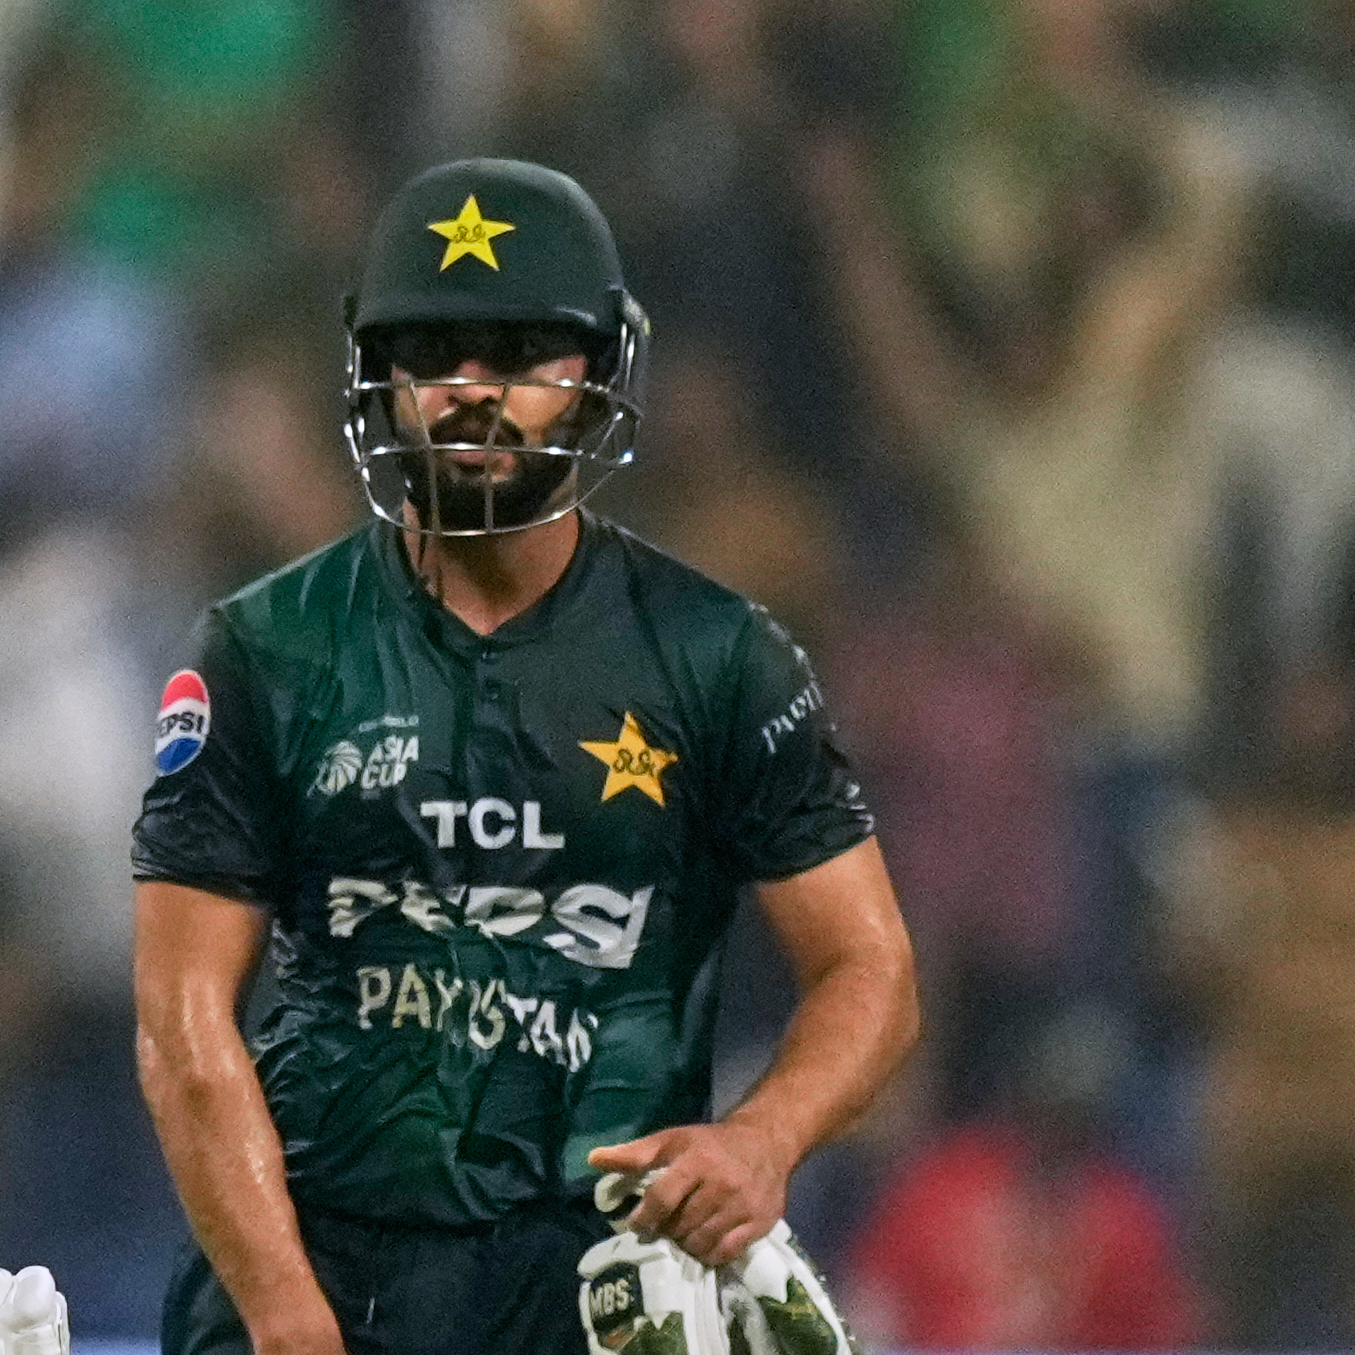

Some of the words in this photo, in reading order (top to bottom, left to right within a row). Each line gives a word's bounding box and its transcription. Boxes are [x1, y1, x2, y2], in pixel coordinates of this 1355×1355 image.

[158, 711, 205, 737] EPSI
[361, 760, 407, 790] CUP
[420, 798, 565, 849] TCL
[590, 1278, 629, 1318] MBS
